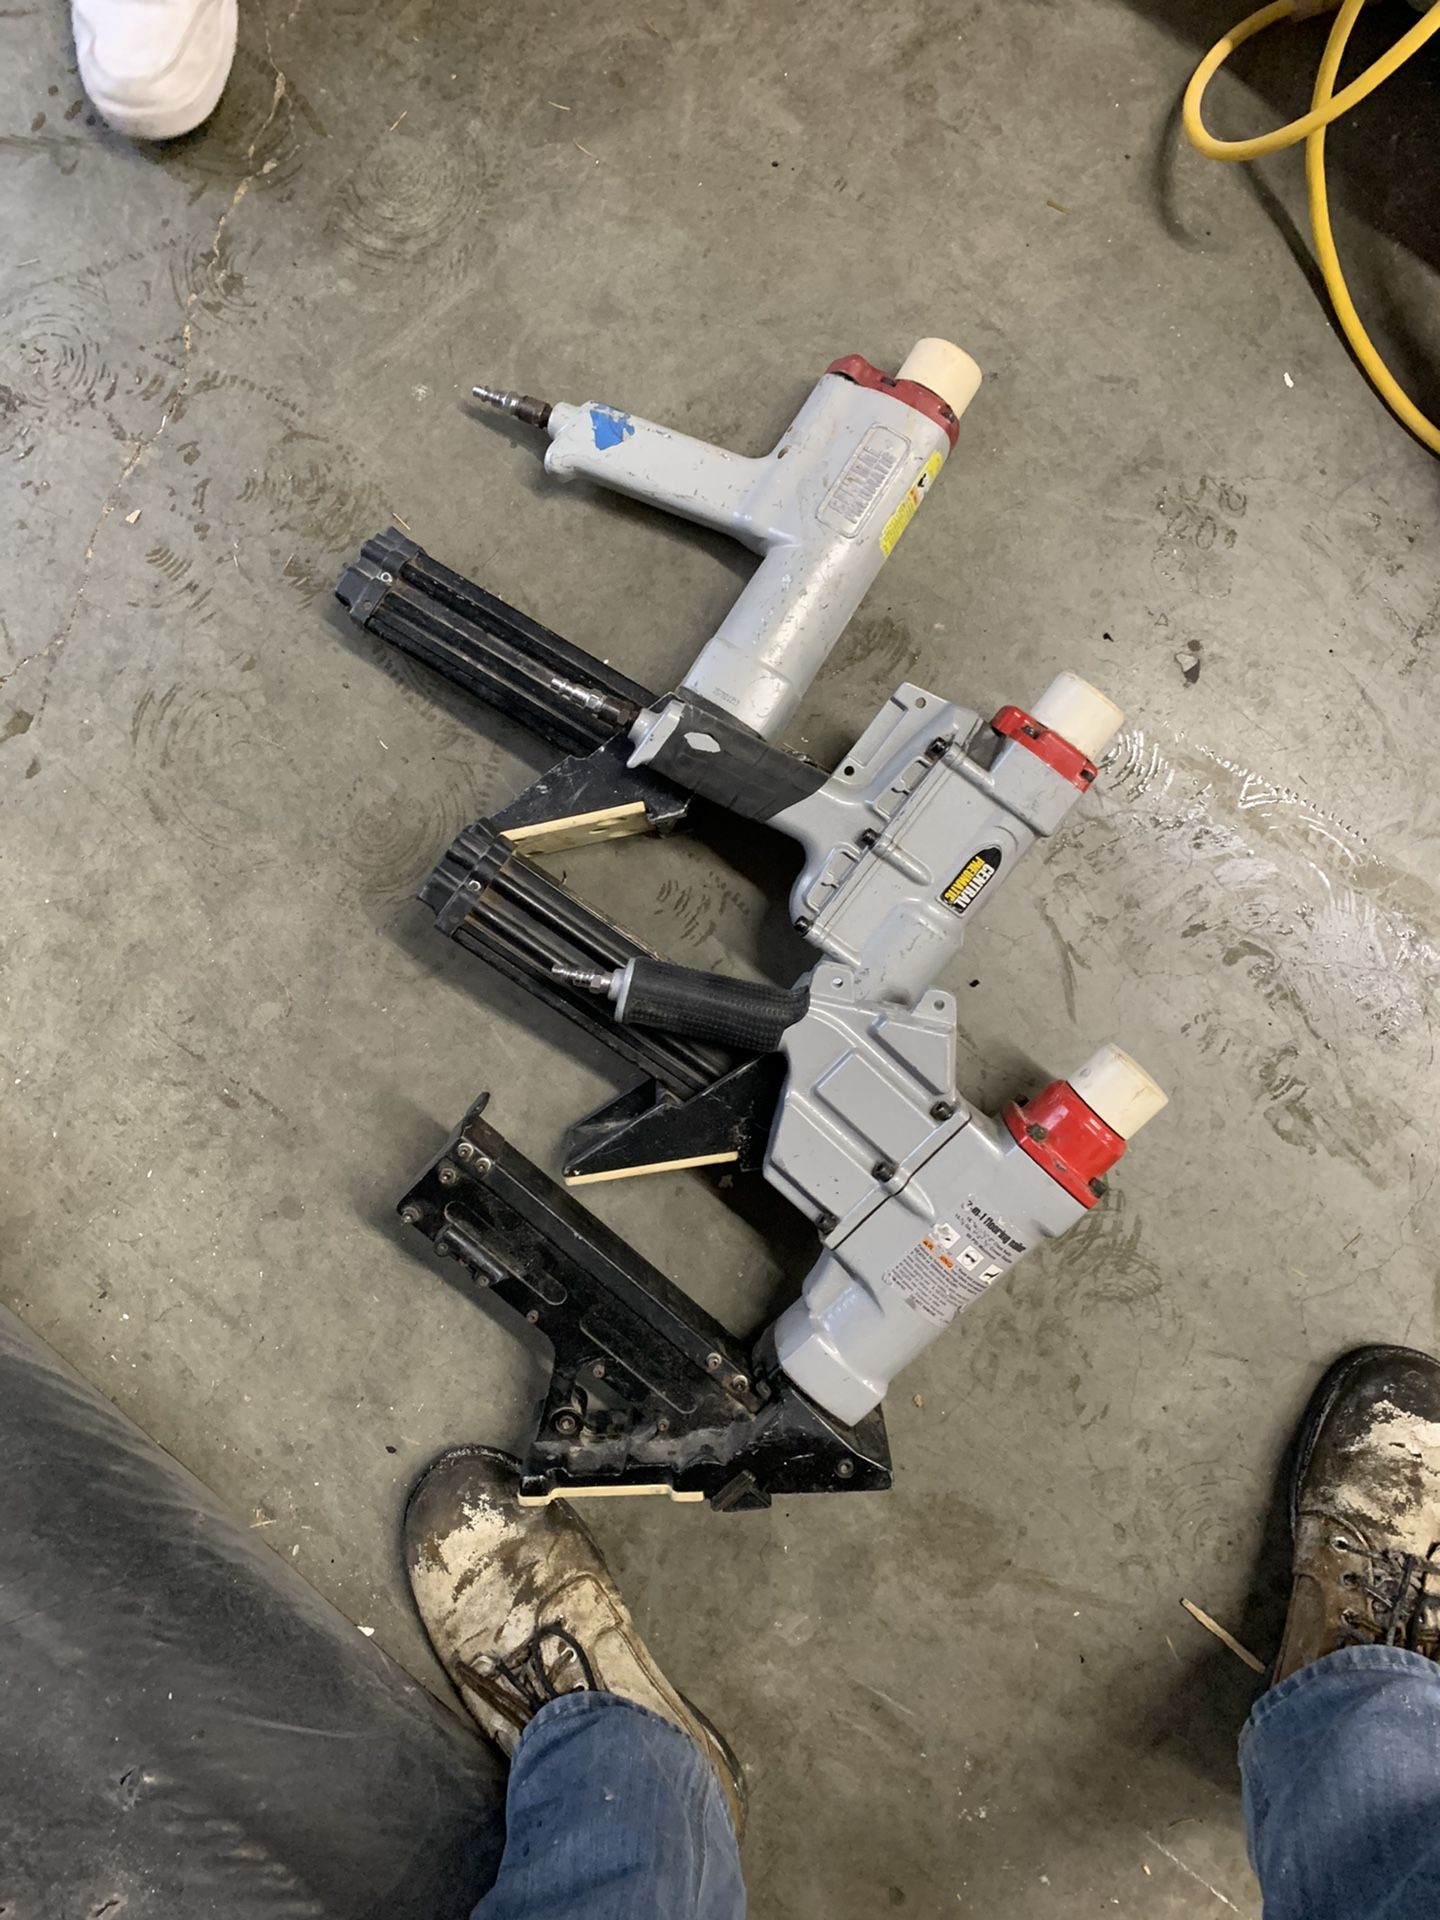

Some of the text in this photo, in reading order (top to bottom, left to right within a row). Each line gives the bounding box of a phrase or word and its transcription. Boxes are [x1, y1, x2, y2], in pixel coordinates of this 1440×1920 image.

[944, 855, 985, 902] PNEUMATIC
[953, 863, 995, 908] CENTRAL
[983, 1216, 1011, 1245] flooring
